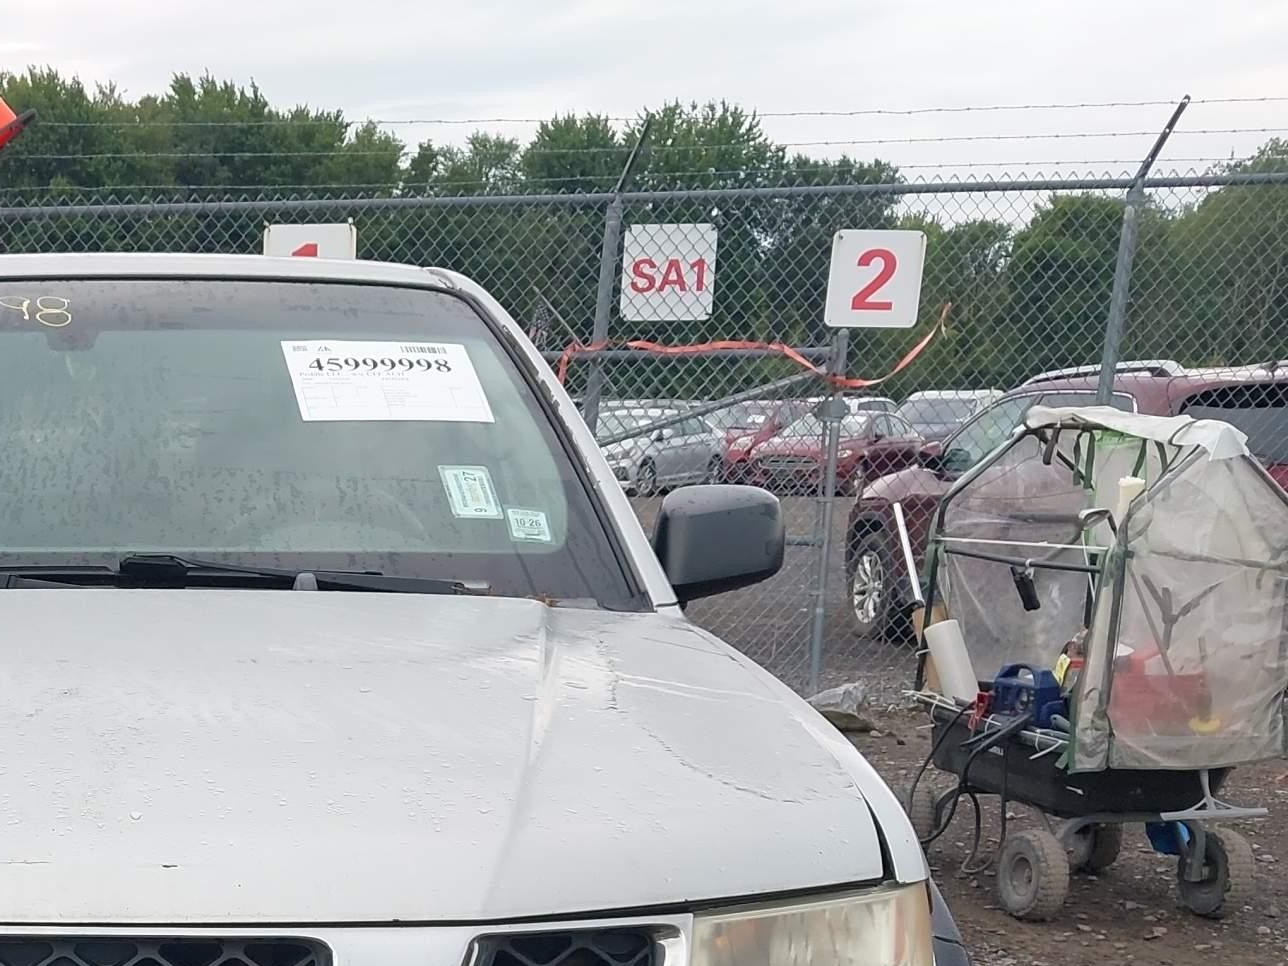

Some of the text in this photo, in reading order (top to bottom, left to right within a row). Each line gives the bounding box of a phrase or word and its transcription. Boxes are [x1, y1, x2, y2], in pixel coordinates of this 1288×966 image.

[630, 257, 706, 293] SA1
[850, 248, 898, 311] 2
[309, 357, 452, 374] 45999998
